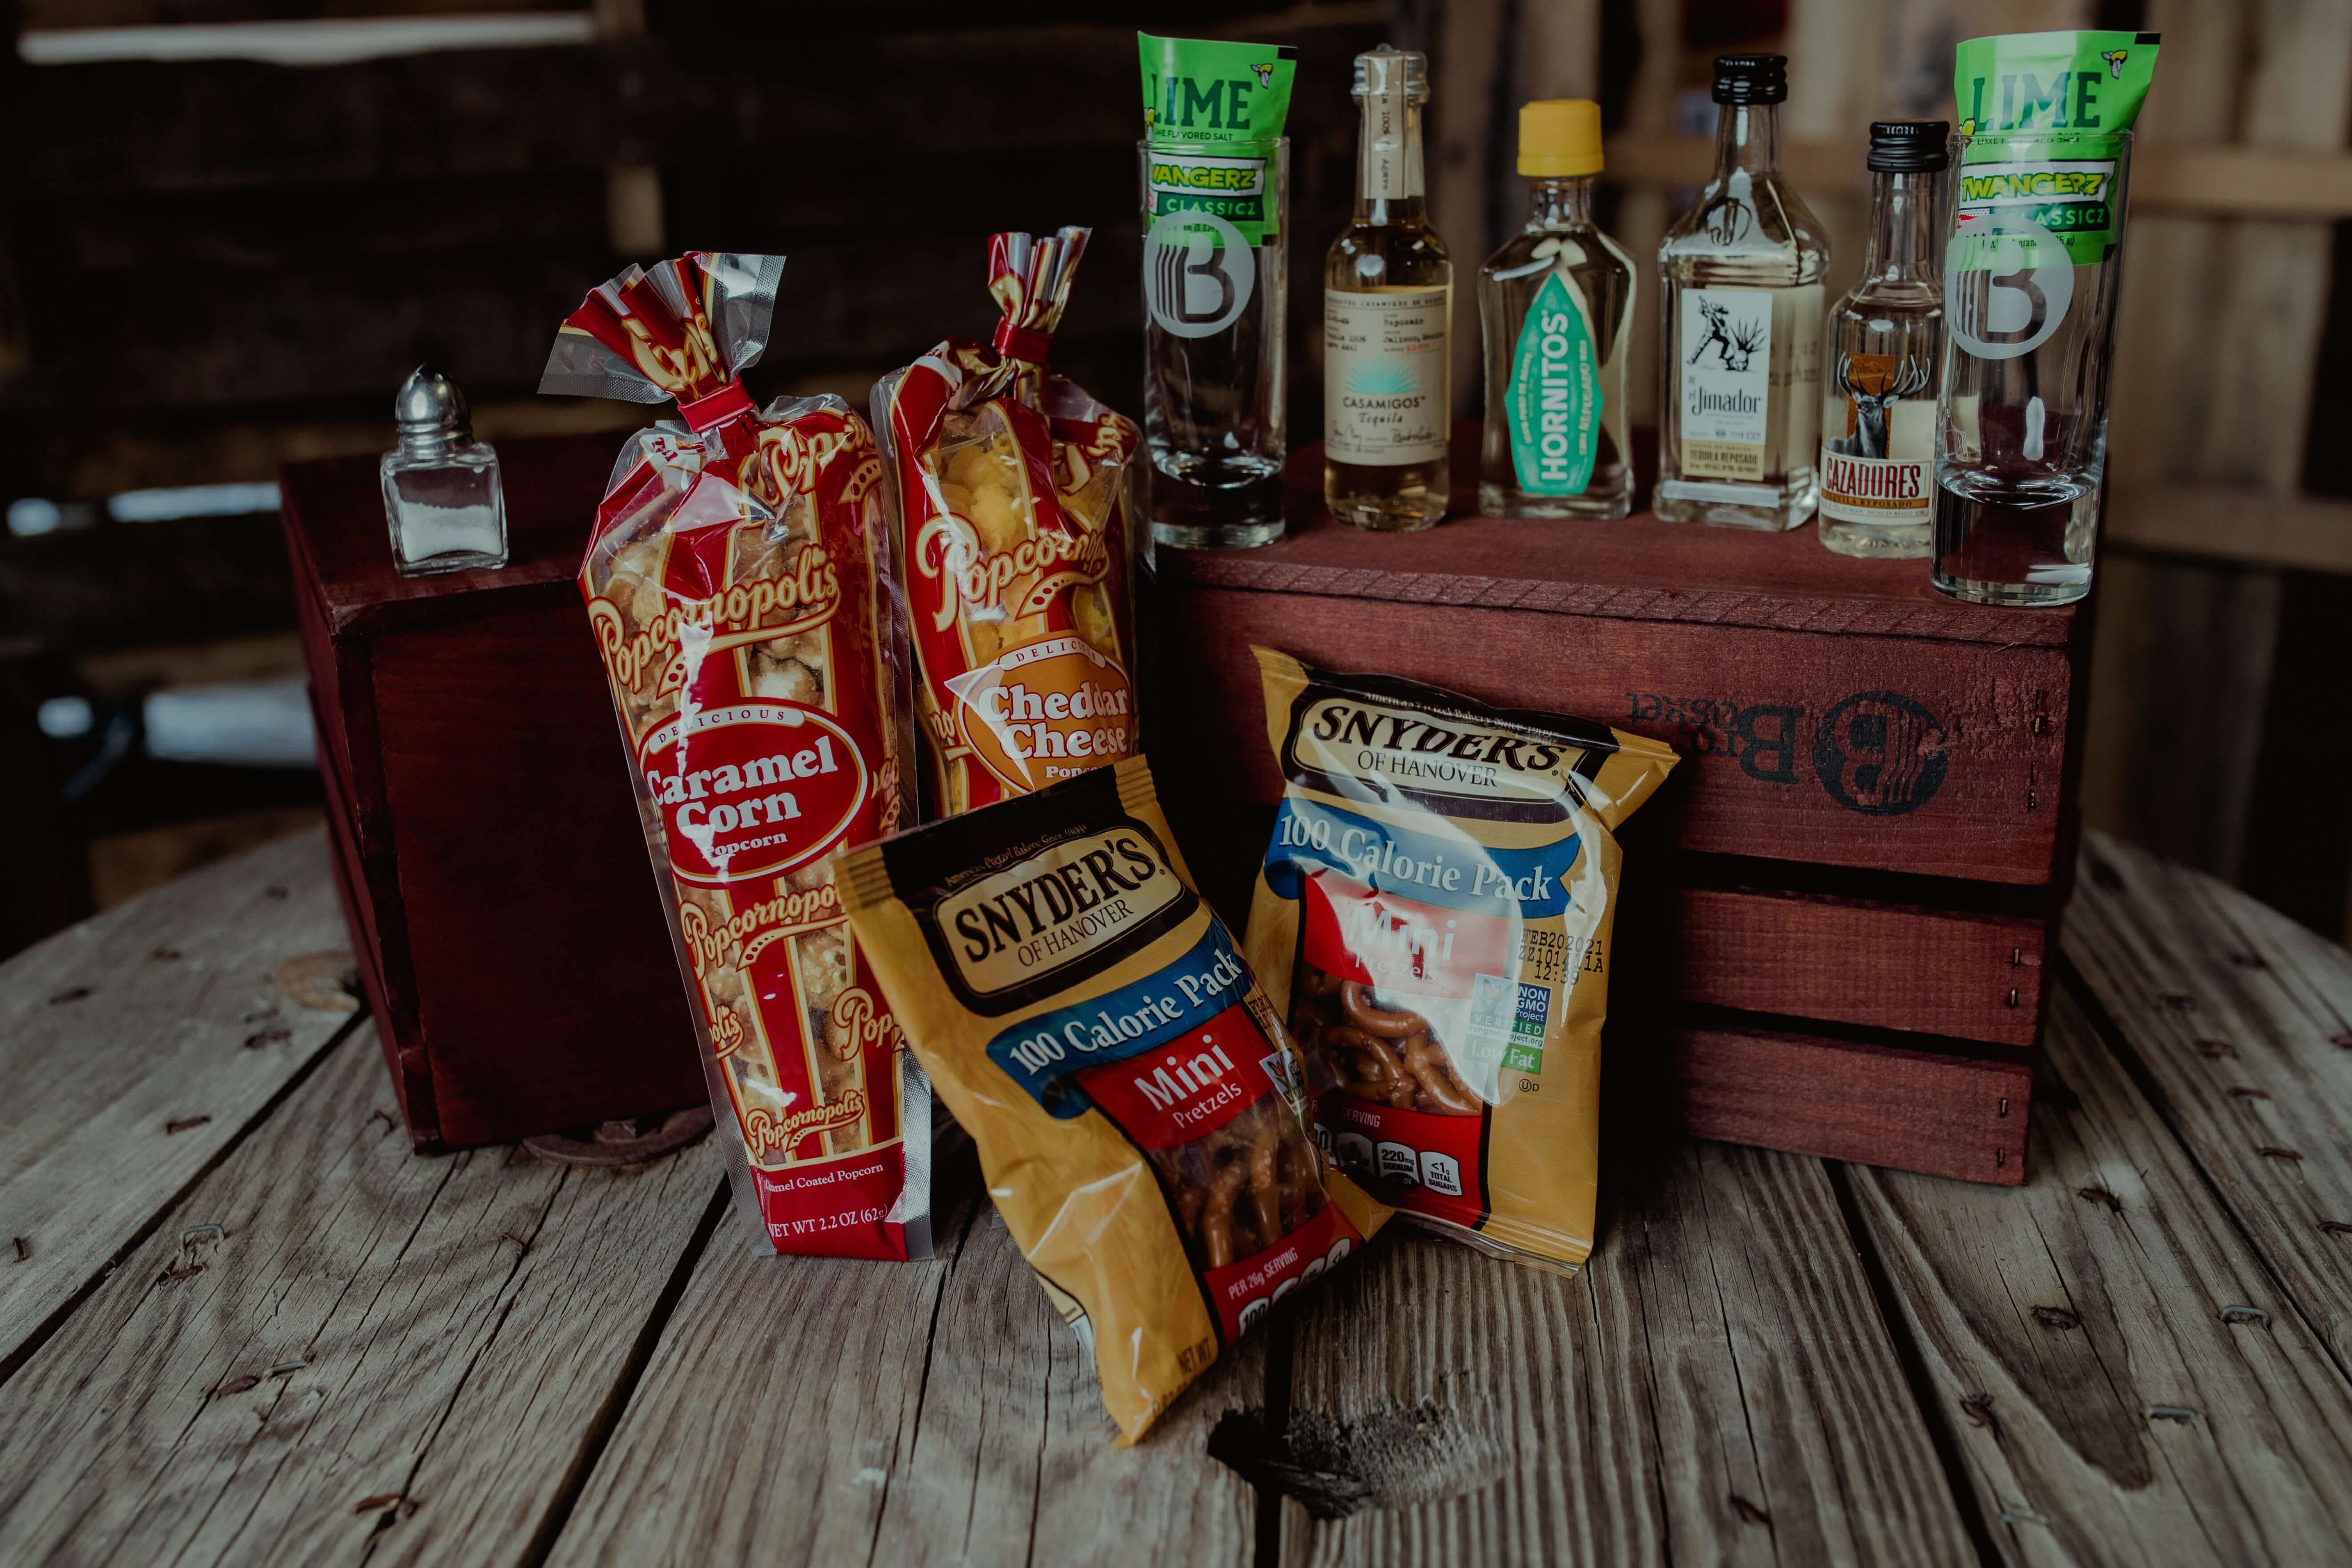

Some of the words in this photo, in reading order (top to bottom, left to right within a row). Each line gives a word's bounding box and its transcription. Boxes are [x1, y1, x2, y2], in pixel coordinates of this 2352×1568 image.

[1973, 72, 2102, 133] LIME
[1213, 133, 1234, 141] SALT
[1166, 198, 1256, 215] CLASSICZ
[2035, 207, 2105, 226] ASSICZ
[1343, 397, 1420, 409] CASAMIGOS
[1541, 312, 1569, 480] HORNITOS
[1692, 386, 1761, 417] Jimador
[1826, 456, 1920, 498] CAZADORES
[1860, 498, 1912, 508] REPOSADO
[588, 544, 841, 696] Popcornopolis
[978, 681, 1128, 722] Cheddar
[658, 709, 785, 743] DELICIOUS
[1000, 722, 1127, 759] Cheese
[1313, 705, 1567, 772] SNYDER'S
[647, 735, 838, 806] Caramel
[1357, 750, 1387, 772] OF
[1390, 753, 1498, 789] HANOVER
[676, 792, 802, 840] Corn
[1279, 813, 1331, 851] 100
[1340, 826, 1462, 892] Calorie
[1473, 863, 1553, 903] Pack
[956, 837, 1156, 963] SNYDER'S
[680, 883, 843, 981] Popcornopo
[1018, 939, 1042, 967] OF
[1045, 899, 1134, 956] HANOVER
[1347, 904, 1456, 960] Mini
[1354, 950, 1438, 983] Pretzels
[1517, 997, 1545, 1012] GMO
[1518, 985, 1547, 1001] NON
[1009, 1031, 1065, 1076] 100
[1064, 996, 1184, 1053] Calorie
[1174, 949, 1243, 1007] Pack
[1475, 1013, 1541, 1035] VERIFIED
[1516, 1008, 1544, 1022] Project
[1471, 1040, 1507, 1058] Low
[1509, 1048, 1535, 1068] Fat
[1134, 1035, 1235, 1112] Mini
[745, 1088, 866, 1159] Popcornopolis
[1172, 1080, 1242, 1129] Pretzels
[796, 1172, 835, 1188] Coated
[836, 1164, 884, 1182] Popcorn
[1384, 1162, 1414, 1173] SODIUM
[1428, 1179, 1457, 1192] SUGARS
[1430, 1171, 1452, 1183] TOTAL
[768, 1222, 790, 1237] NET
[791, 1218, 816, 1235] WT
[819, 1215, 838, 1231] 2.2
[839, 1211, 858, 1227] OZ
[860, 1203, 888, 1224] (62g)
[1228, 1280, 1249, 1300] PER
[1248, 1271, 1265, 1290] 26g
[1263, 1246, 1299, 1278] SERVING
